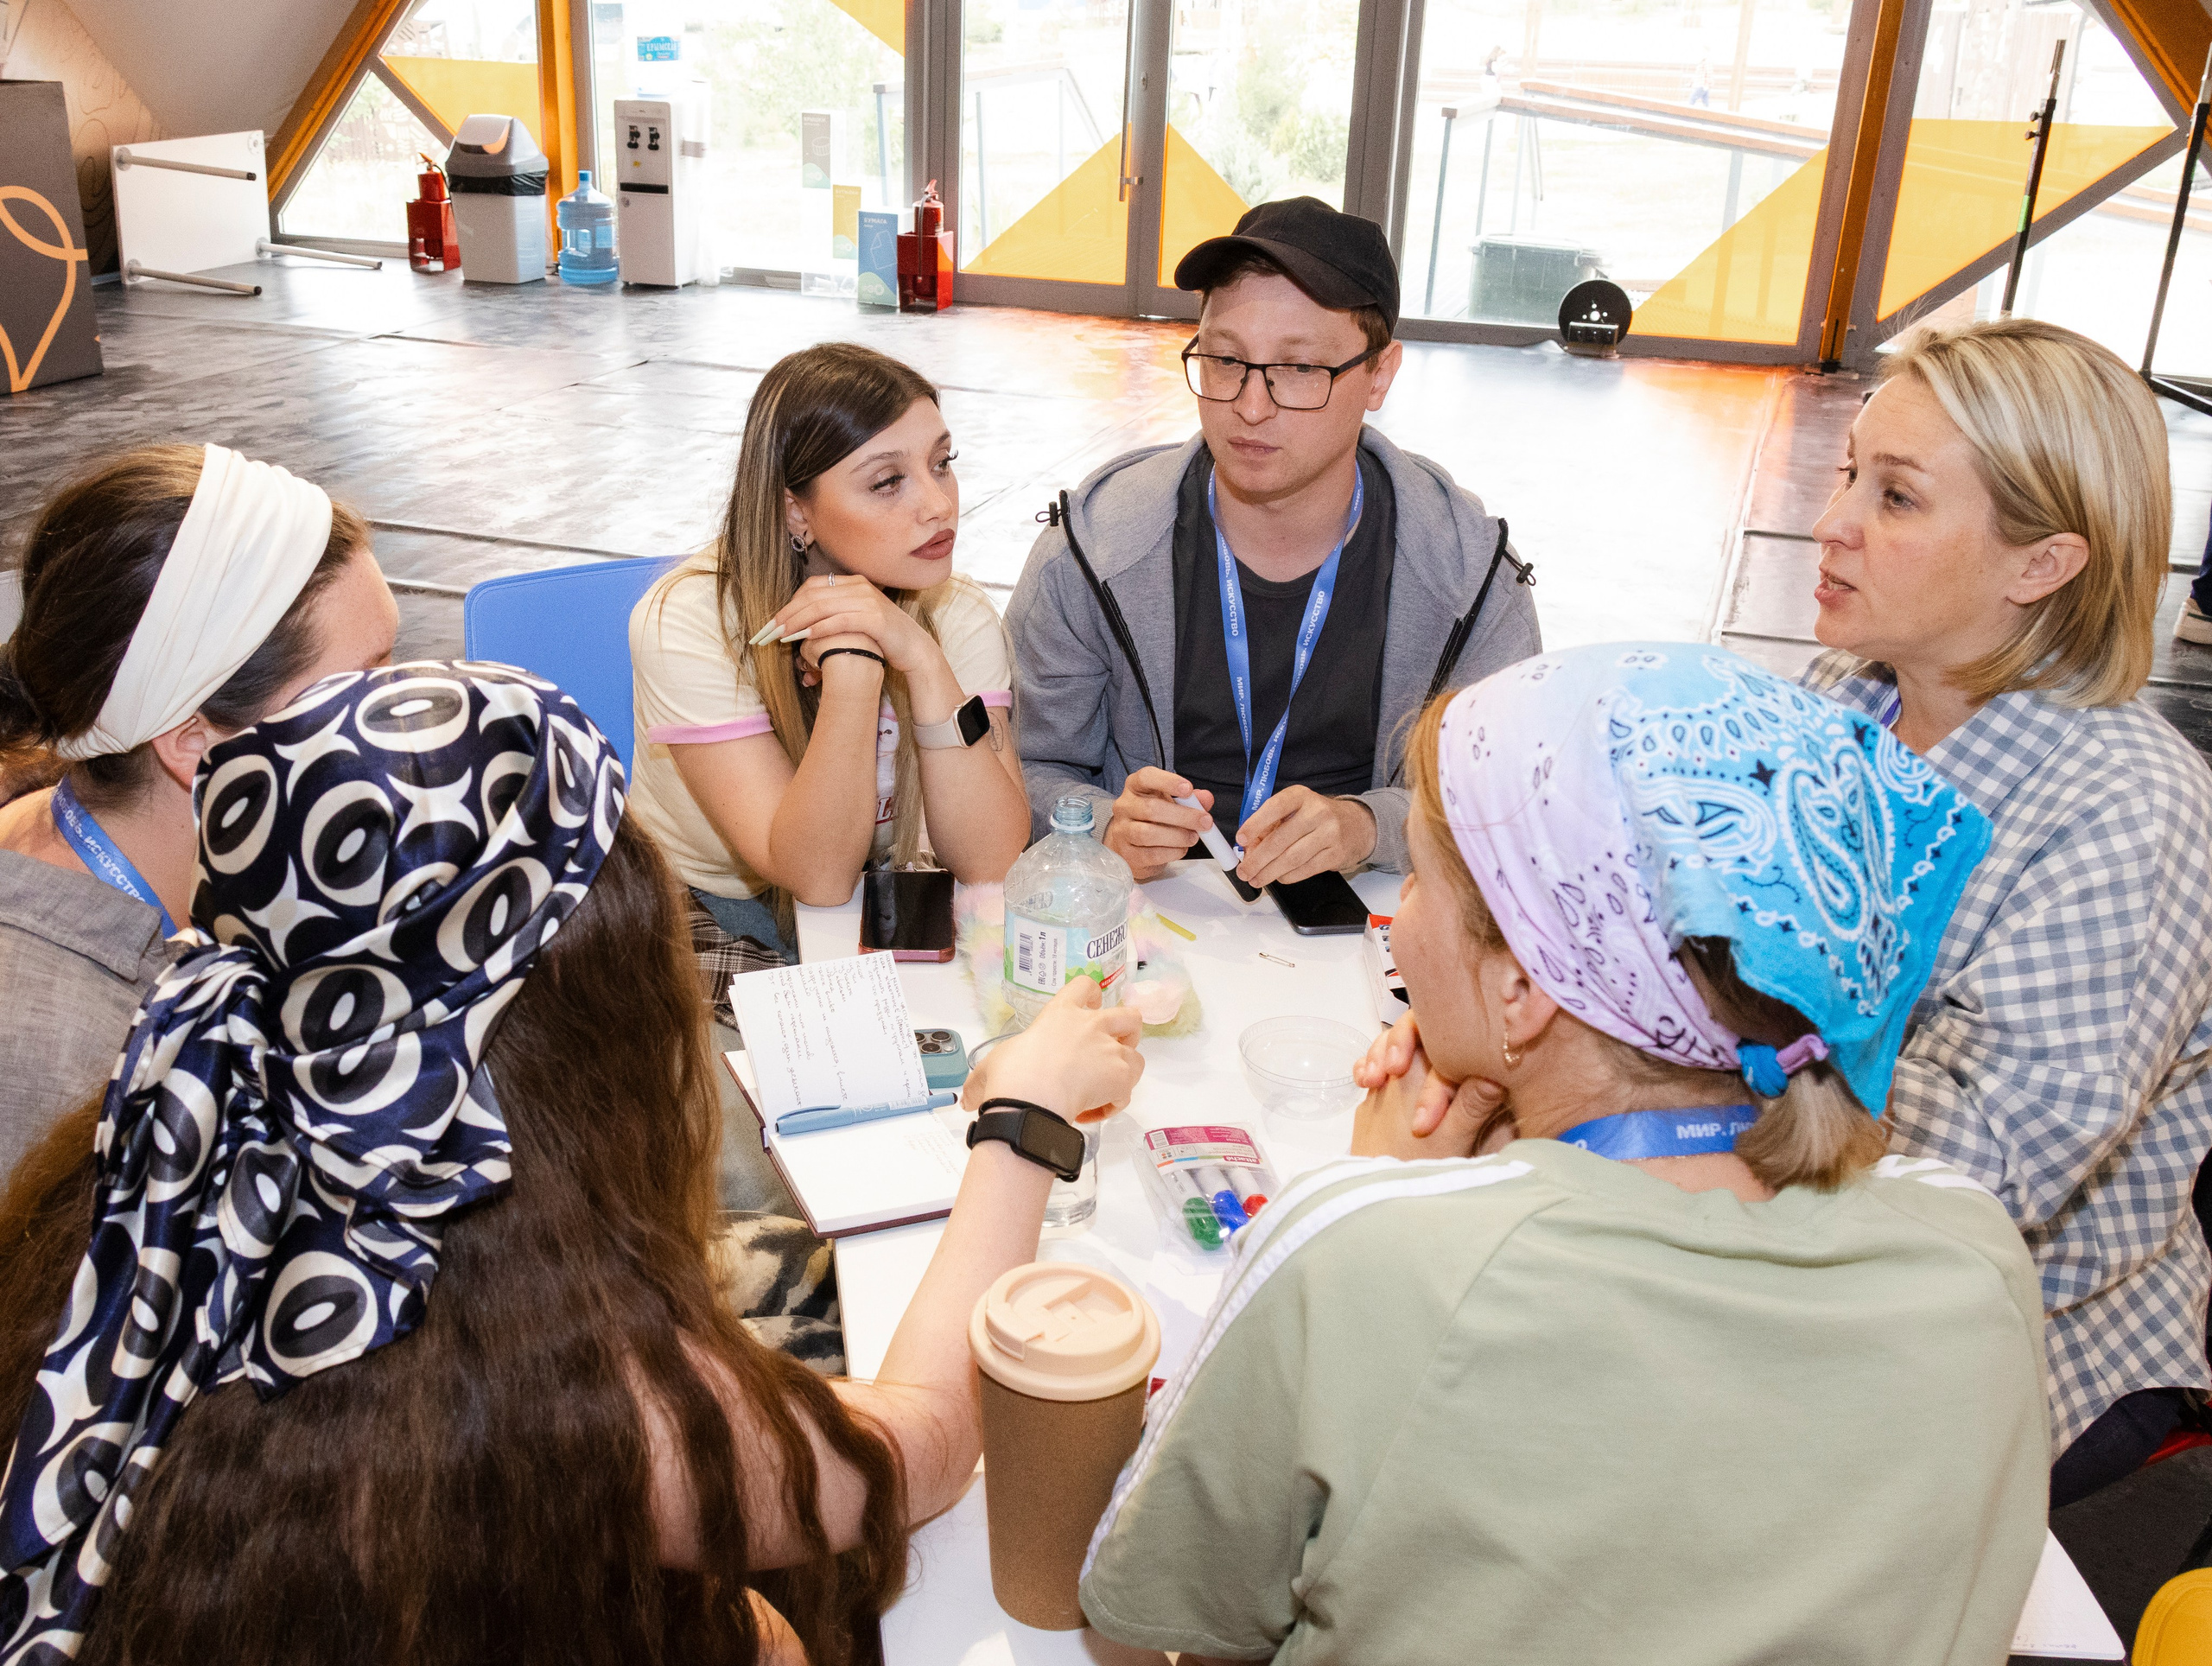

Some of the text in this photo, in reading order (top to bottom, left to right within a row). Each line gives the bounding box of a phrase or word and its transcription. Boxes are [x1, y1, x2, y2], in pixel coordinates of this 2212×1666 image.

[1226, 580, 1239, 636] ИСКУССТВО
[1303, 590, 1325, 646] ИСКУССТВО
[1236, 677, 1245, 701] МИР.
[1251, 788, 1264, 811] МИР.
[1259, 744, 1276, 787] ЛЮБОВЬ.
[1676, 1122, 1727, 1140] МИР.
